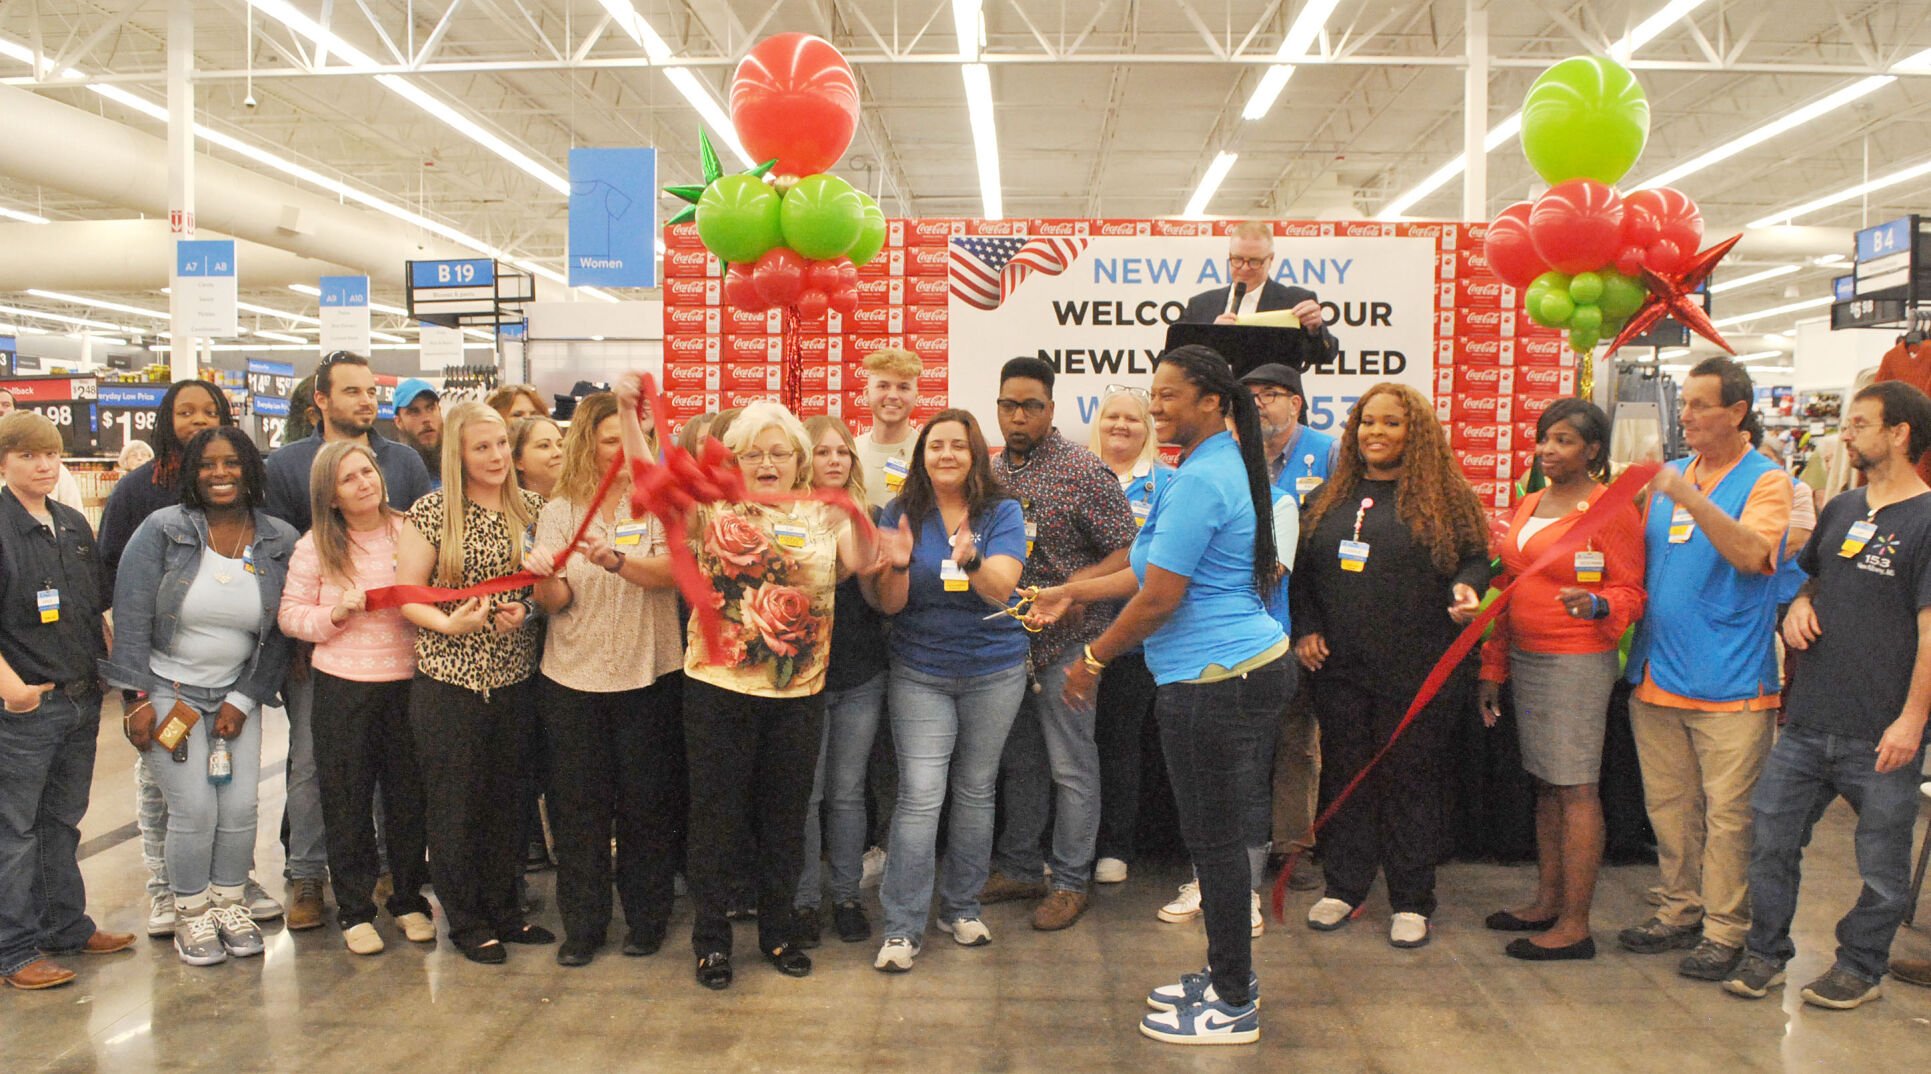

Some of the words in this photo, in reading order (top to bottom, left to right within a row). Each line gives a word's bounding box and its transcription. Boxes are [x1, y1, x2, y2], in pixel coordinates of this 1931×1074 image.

[1873, 230, 1883, 253] B
[1884, 227, 1894, 249] 4
[580, 257, 623, 269] Women
[1094, 258, 1183, 284] NEW
[438, 264, 451, 282] B
[454, 264, 475, 283] 19
[1052, 300, 1186, 326] WELCO
[138, 392, 155, 401] Price
[1865, 554, 1891, 568] 153
